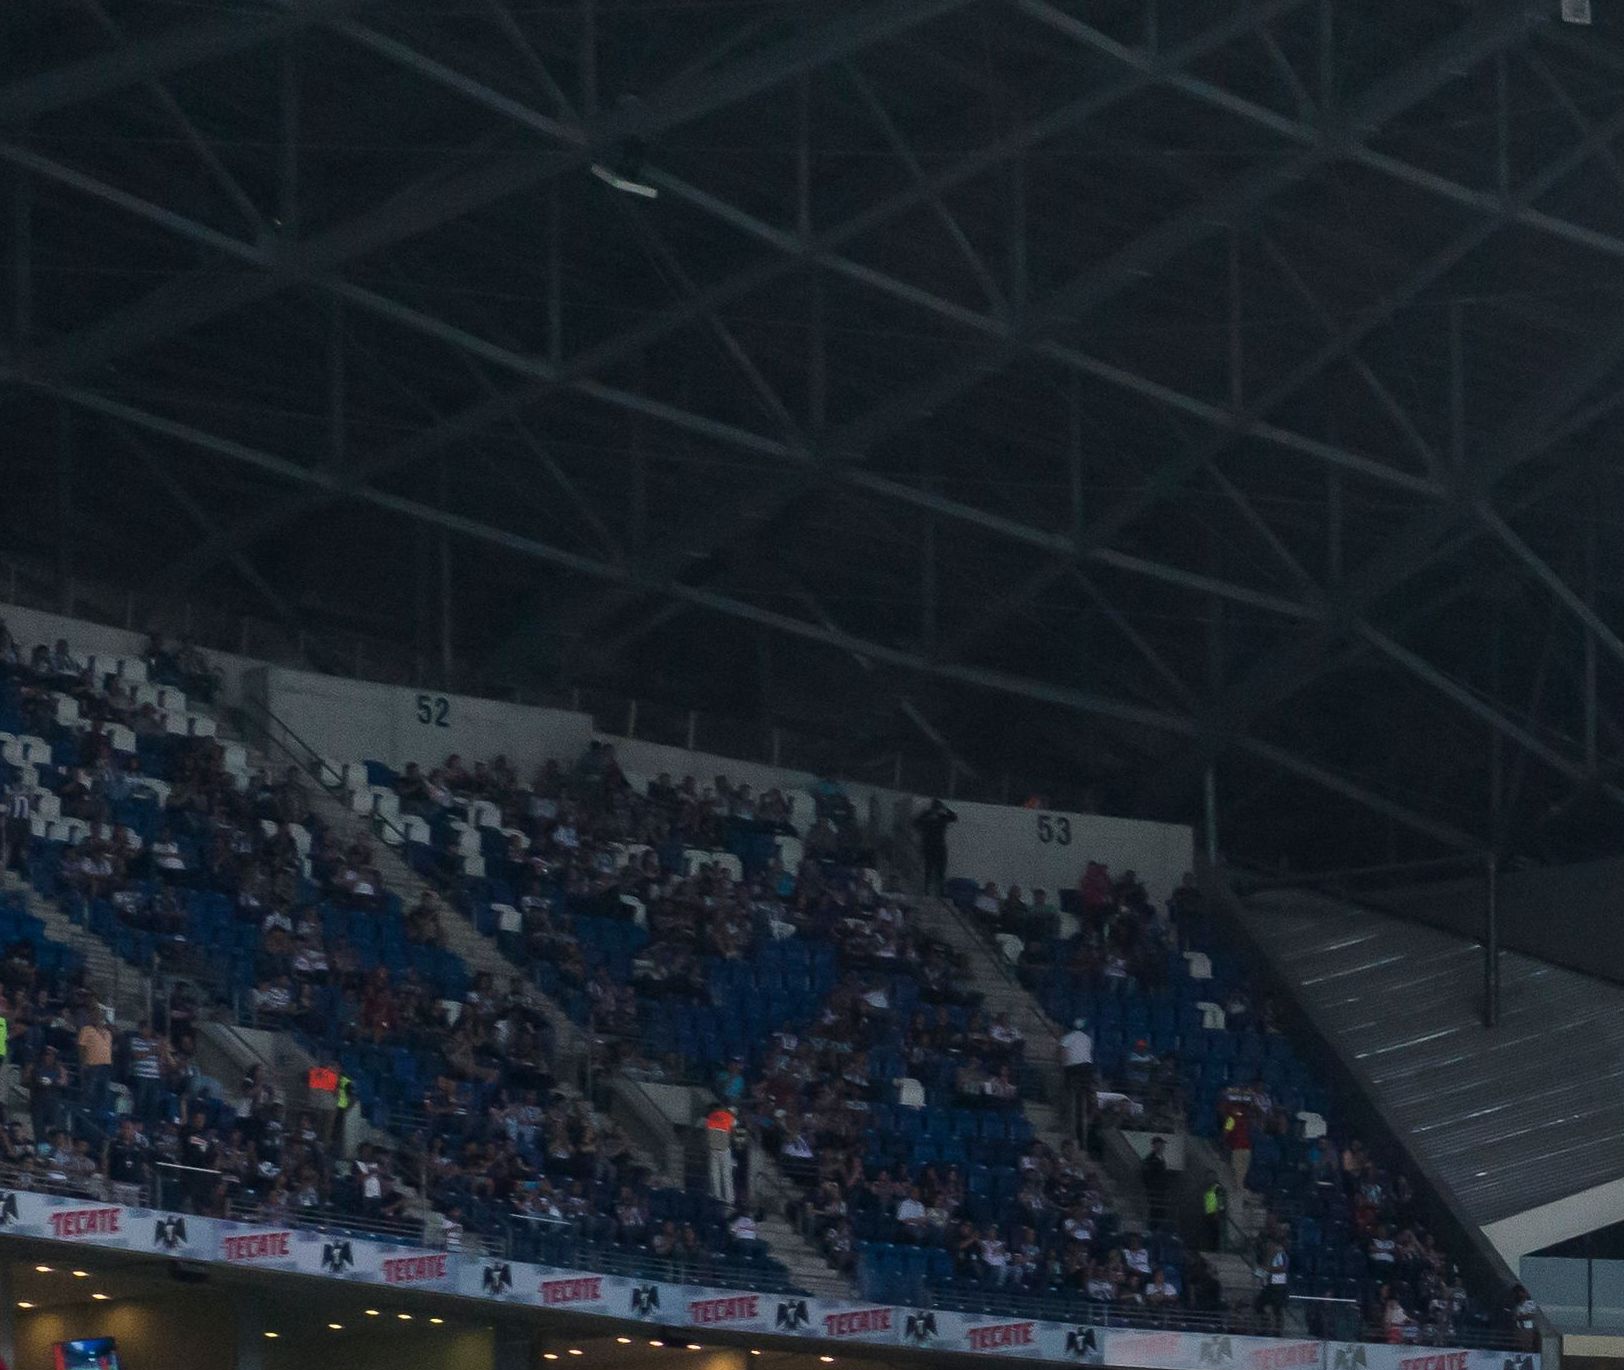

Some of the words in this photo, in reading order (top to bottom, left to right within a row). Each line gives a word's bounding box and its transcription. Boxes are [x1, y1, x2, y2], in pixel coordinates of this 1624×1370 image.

[417, 695, 450, 728] 52
[1038, 815, 1071, 845] 53
[50, 1208, 120, 1236] TECATE
[382, 1255, 448, 1285] TECATE
[689, 1296, 759, 1326] TECATE
[966, 1322, 1034, 1351] TECATE
